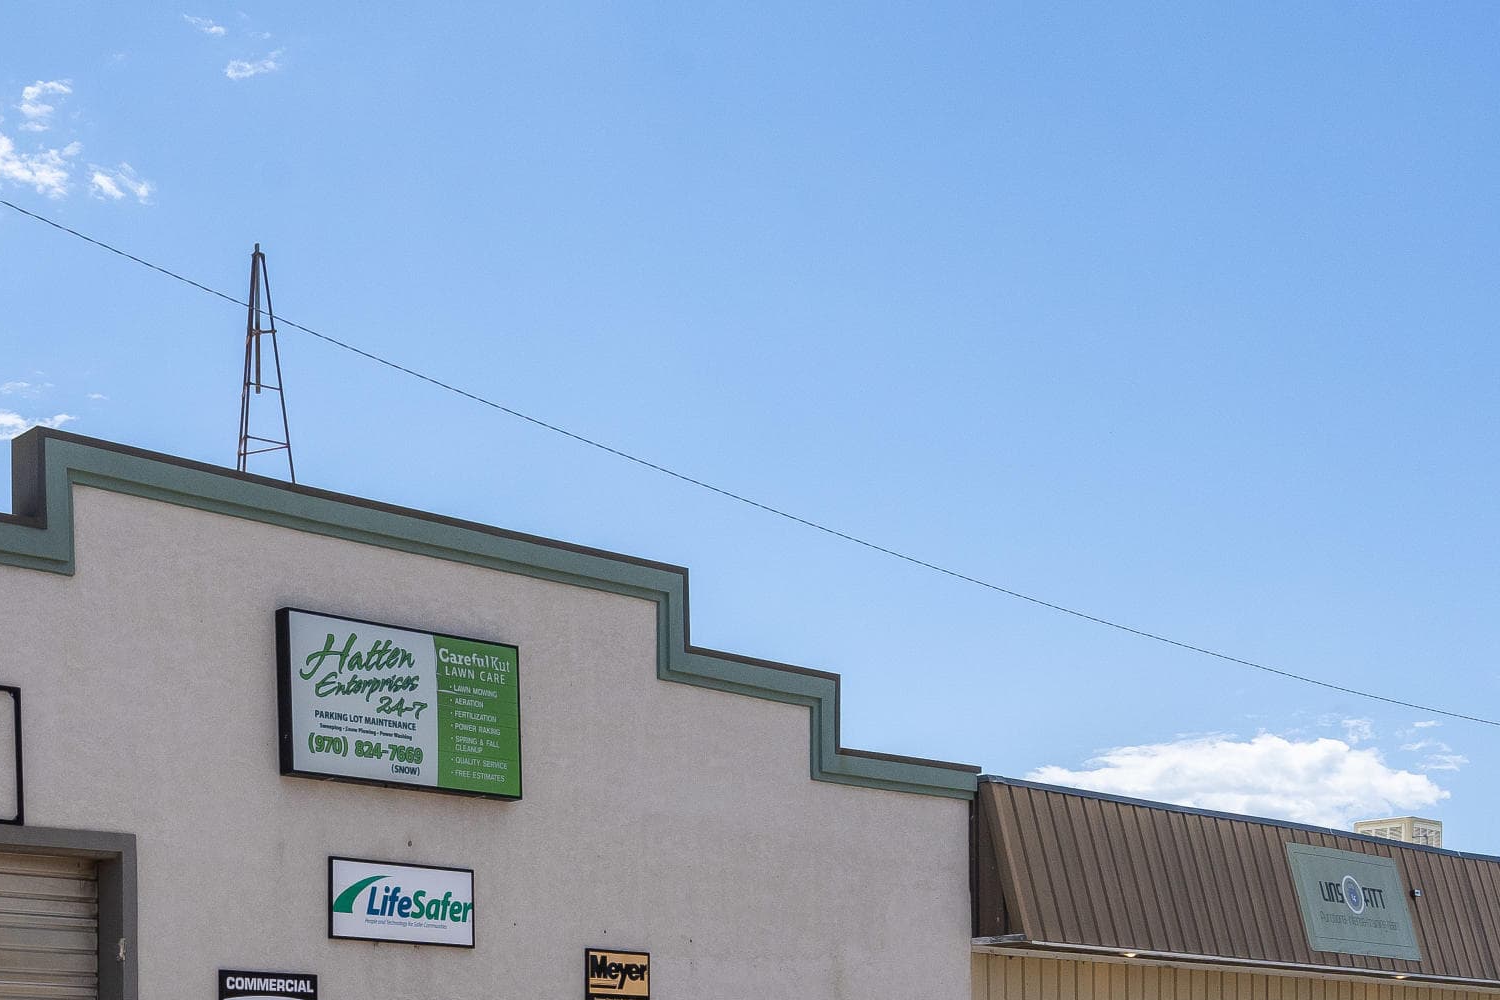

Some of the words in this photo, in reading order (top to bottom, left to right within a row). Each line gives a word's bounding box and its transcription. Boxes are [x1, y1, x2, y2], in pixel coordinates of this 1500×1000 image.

[299, 633, 415, 680] Hatten
[445, 666, 475, 680] LAWN
[480, 671, 506, 685] CARE
[315, 672, 420, 702] Enterprises
[453, 684, 471, 694] LAWN
[472, 687, 498, 698] MOWING
[376, 696, 428, 720] 24-7
[454, 698, 484, 708] AERATION
[314, 709, 348, 722] PARKING
[349, 714, 363, 723] LOT
[364, 716, 417, 731] MAINTENANCE
[454, 710, 497, 722] FERTILIZATION
[454, 723, 479, 733] POWER
[308, 732, 348, 757] (970)
[355, 740, 424, 764] 824-7669
[455, 735, 478, 746] SPRING
[486, 740, 500, 748] FALL
[455, 744, 483, 753] CLEANUP
[391, 764, 420, 776] (SNOW)
[456, 756, 480, 766] QUALITY
[483, 760, 508, 770] SERVICE
[455, 770, 471, 778] FREE
[473, 773, 506, 783] ESTIMATES
[366, 886, 472, 922] LifeSafer
[590, 955, 647, 989] Meyer
[226, 977, 314, 993] COMMERCIAL
